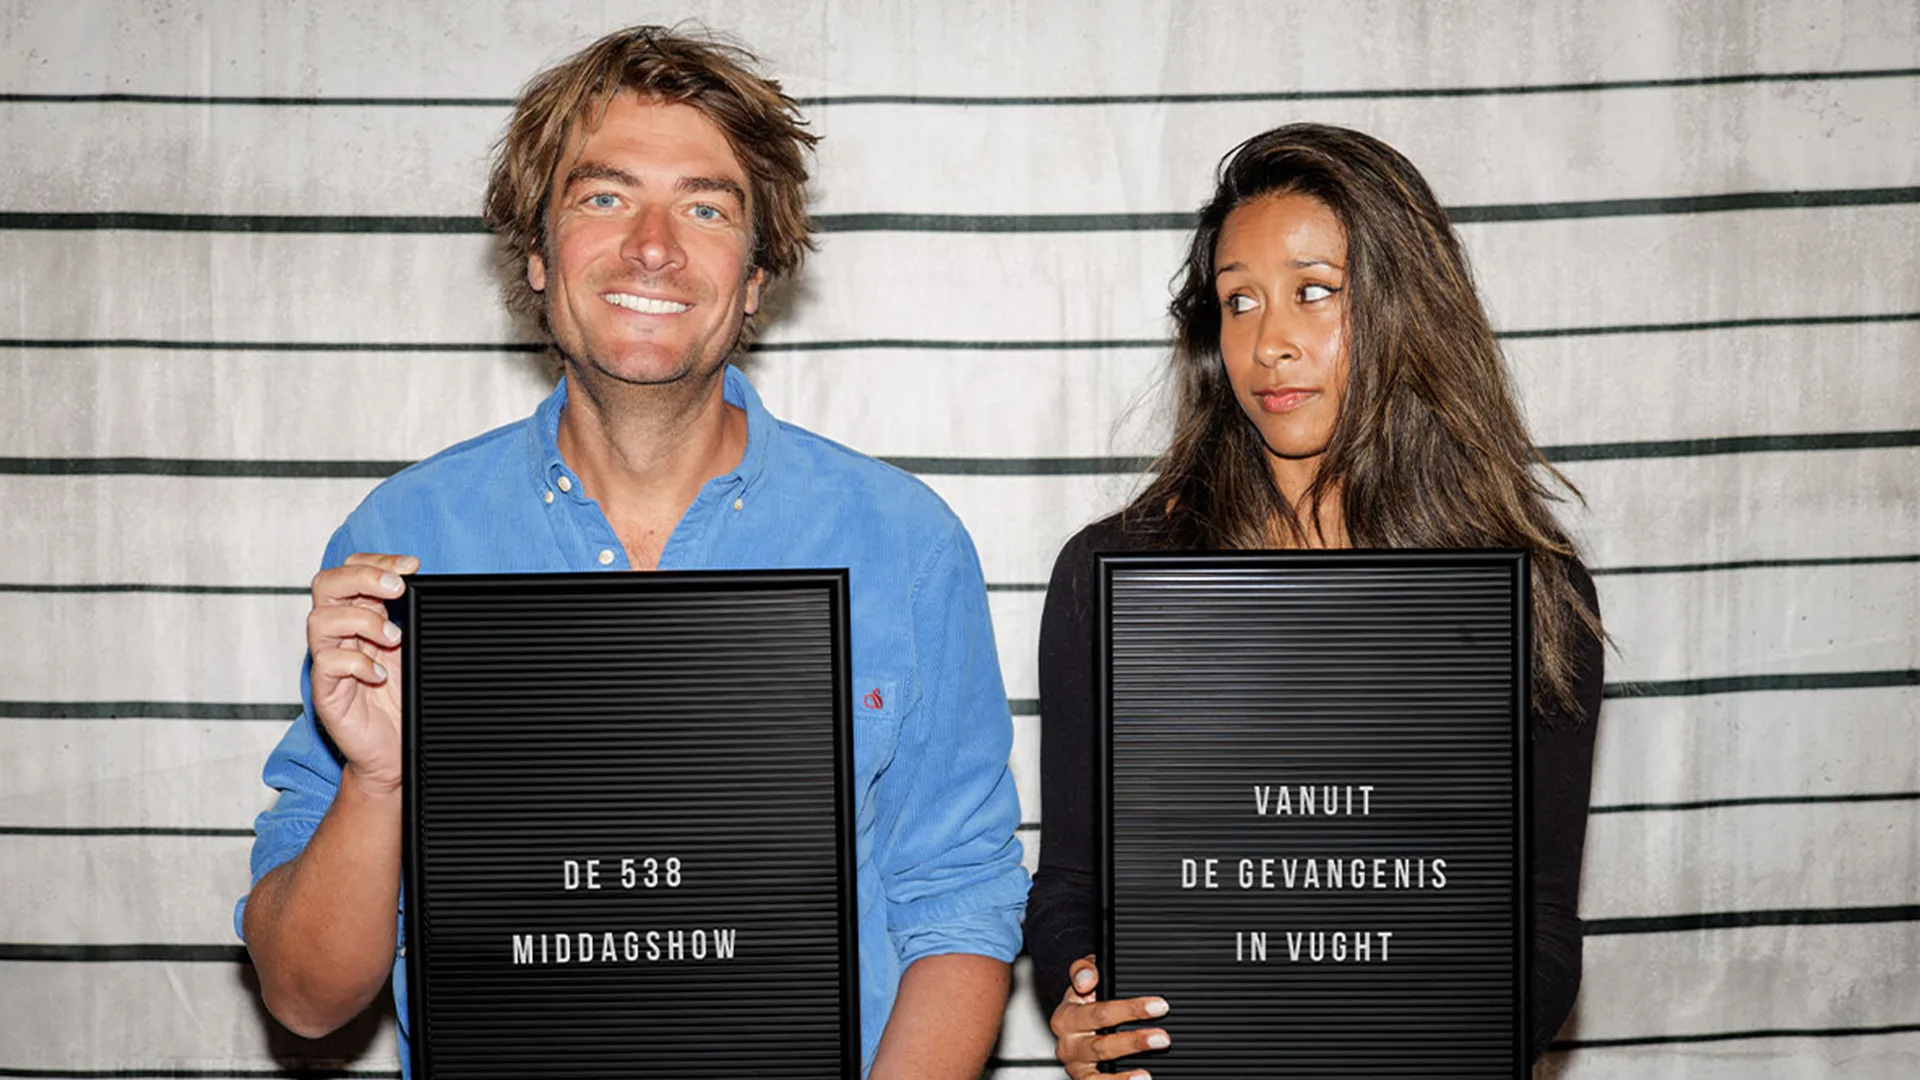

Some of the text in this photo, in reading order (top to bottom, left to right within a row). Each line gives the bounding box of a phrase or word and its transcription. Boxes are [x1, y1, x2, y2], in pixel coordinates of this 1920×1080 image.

[1254, 785, 1374, 816] VANUIT
[563, 856, 681, 890] DE 538
[1181, 857, 1448, 889] DE GEVANGENIS
[512, 928, 737, 965] MIDDAGSHOW
[1235, 931, 1393, 962] IN VUGHT
